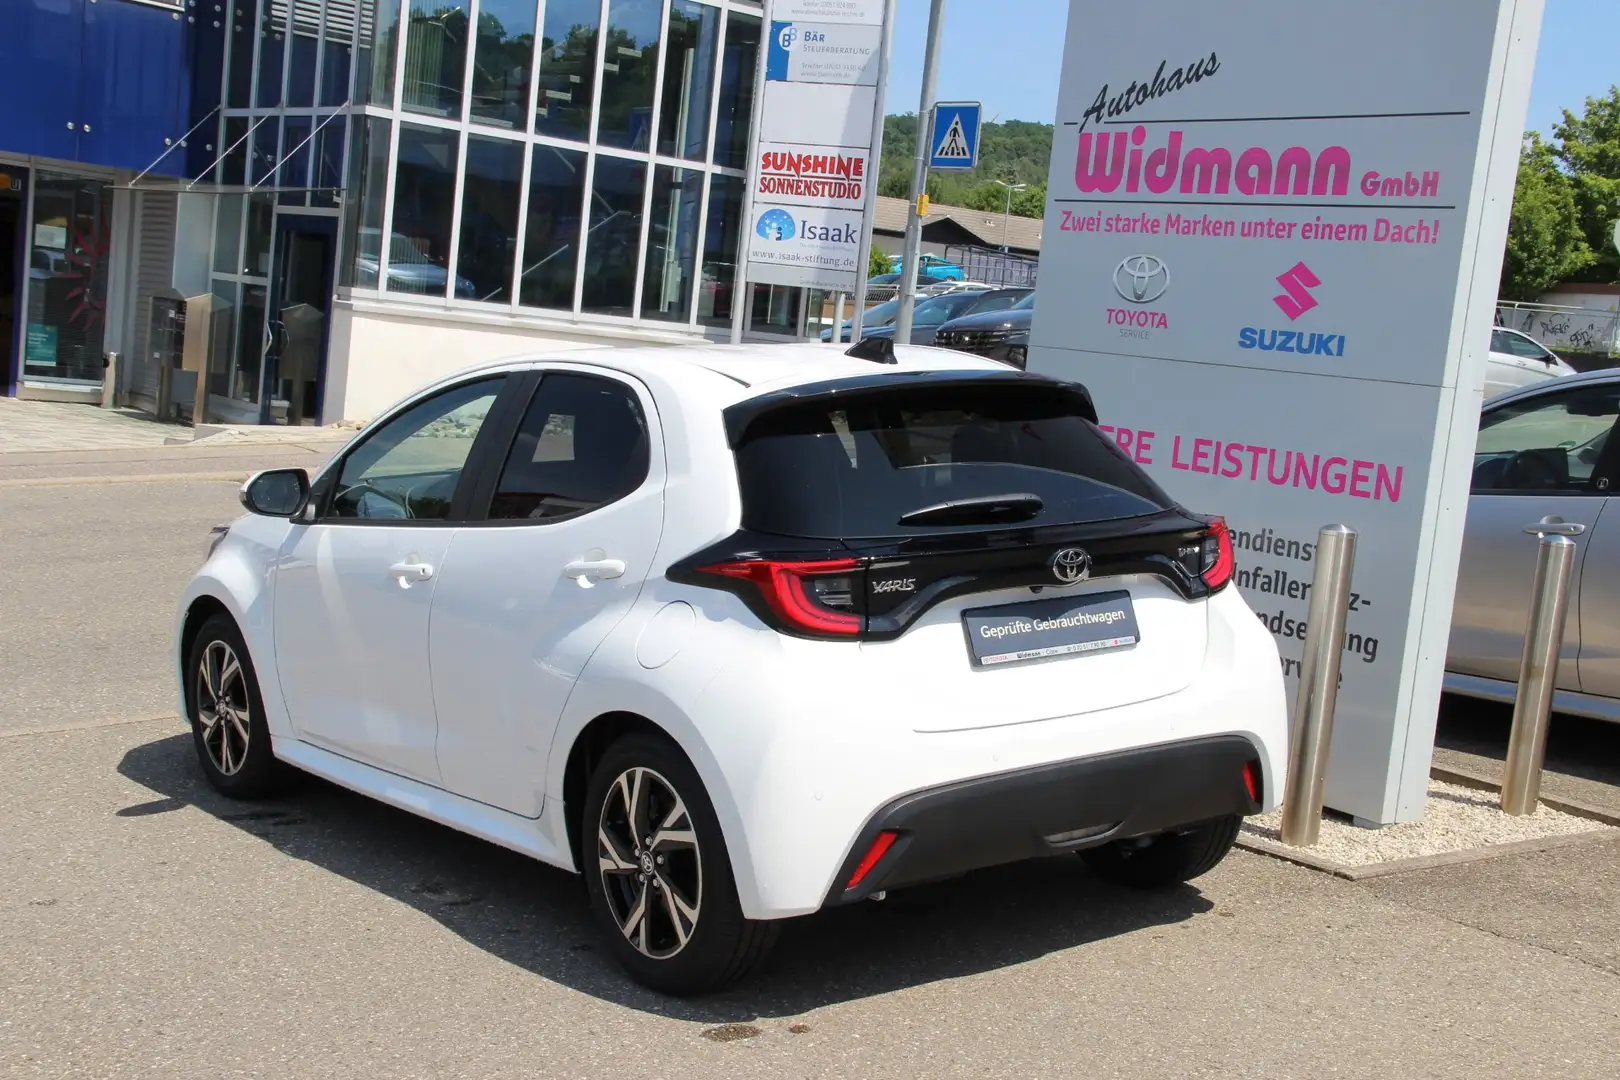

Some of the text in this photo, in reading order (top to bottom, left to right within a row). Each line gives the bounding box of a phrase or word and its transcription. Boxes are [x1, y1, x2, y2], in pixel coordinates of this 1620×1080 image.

[803, 45, 870, 55] STEUERBERATUNG
[1079, 52, 1220, 133] Autohaus
[762, 150, 864, 181] SUNSHINE
[1075, 125, 1440, 197] Widmann GmbH
[760, 177, 861, 199] SONNENSTUDIO
[799, 220, 858, 243] Isaak
[1060, 210, 1440, 244] Zwei starke Marken unter einem Dach!
[752, 250, 855, 267] www.isaak-stiftung.de
[1106, 308, 1168, 329] TOYOTA
[1119, 328, 1150, 340] SERVICE
[1238, 327, 1346, 357] SUZUKI
[1099, 425, 1403, 503] RE LEISTUNGEN
[872, 578, 916, 593] YARIS
[980, 609, 1126, 639] Geprüfte Gebrauchtwagen
